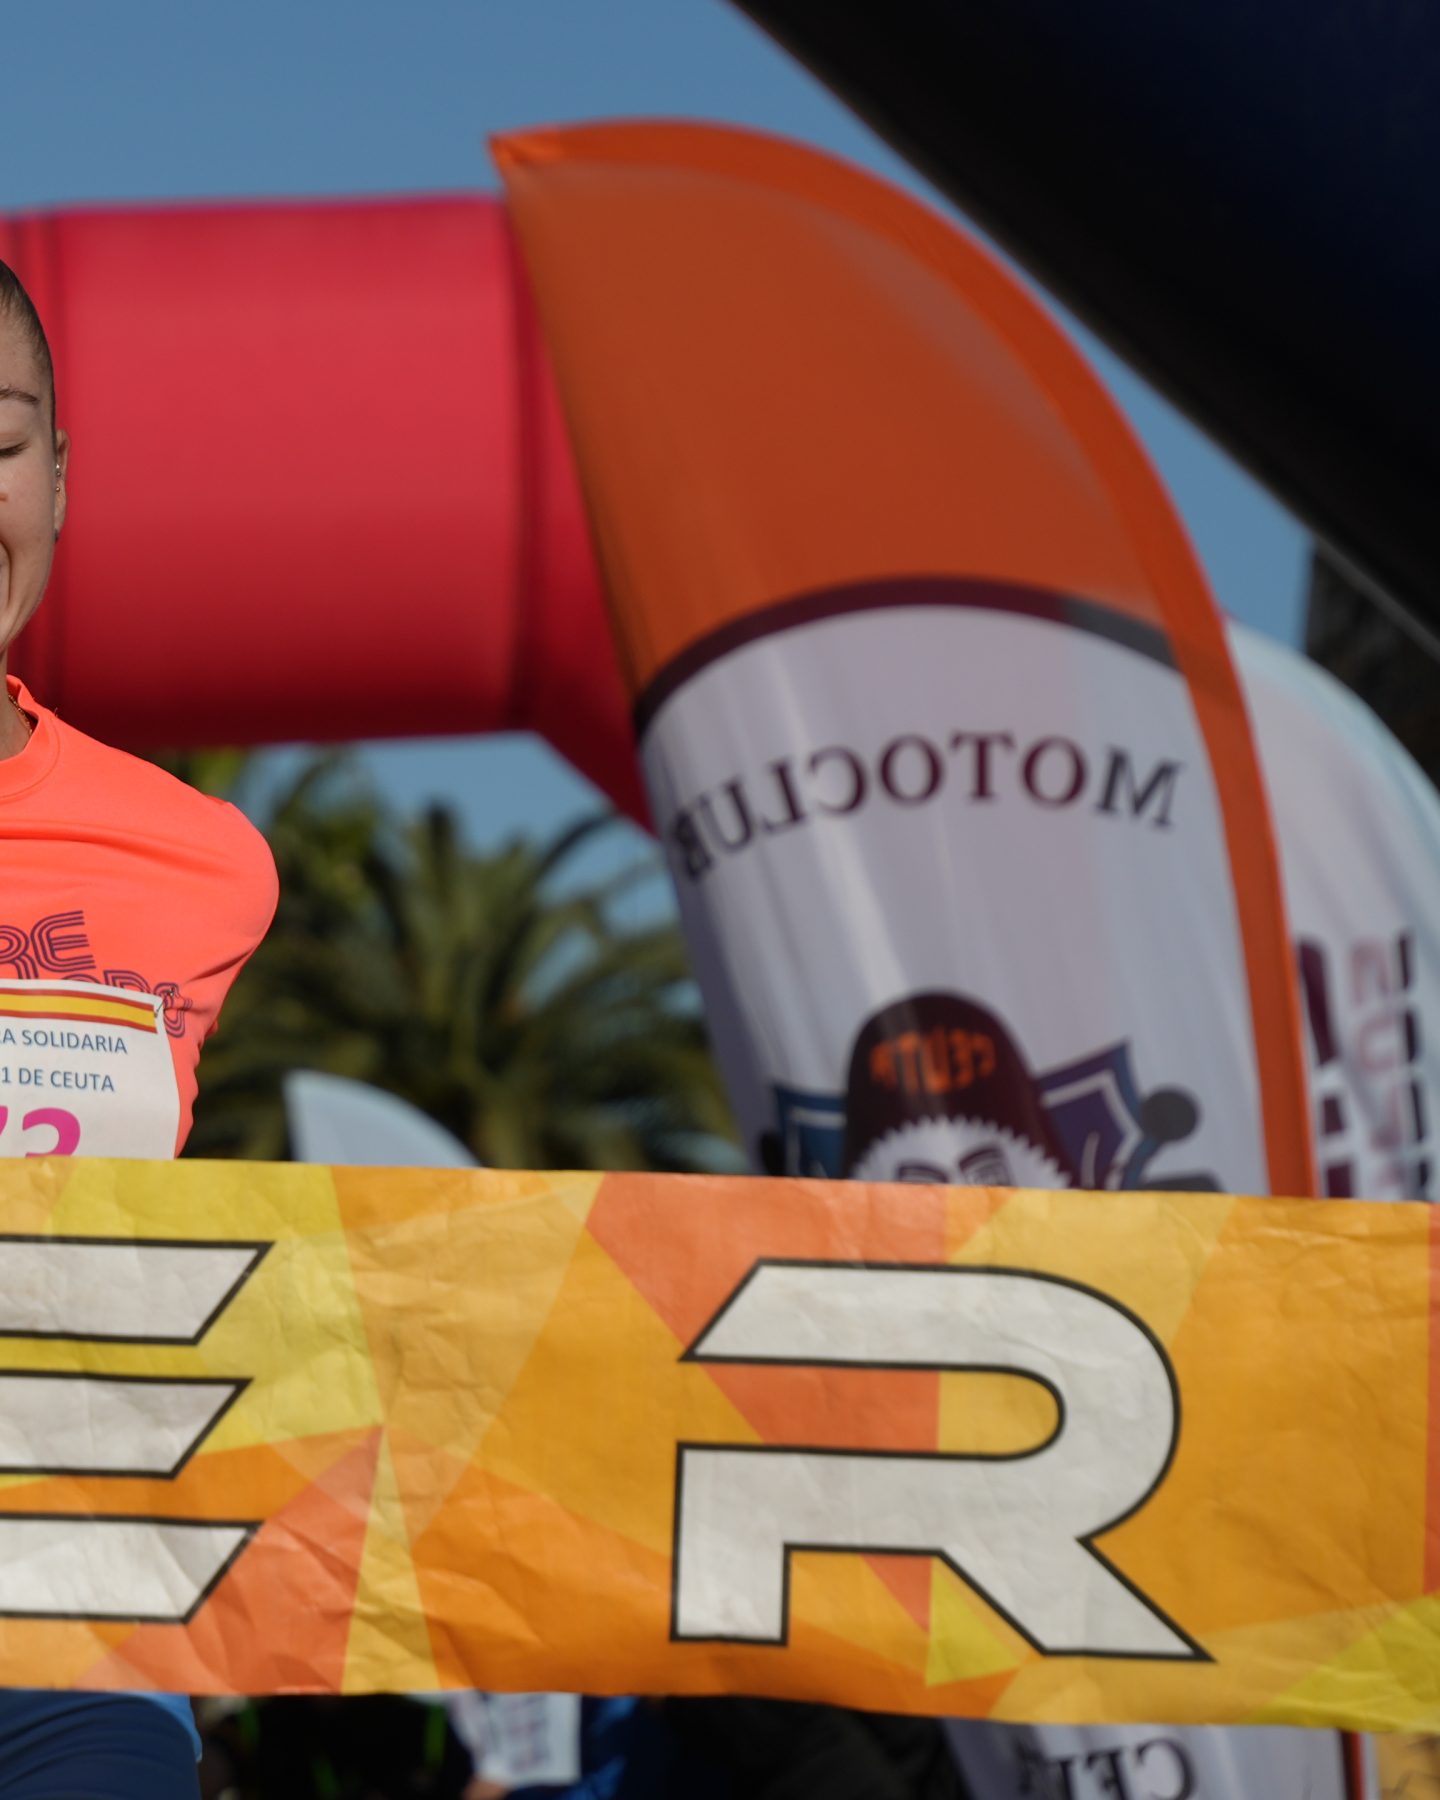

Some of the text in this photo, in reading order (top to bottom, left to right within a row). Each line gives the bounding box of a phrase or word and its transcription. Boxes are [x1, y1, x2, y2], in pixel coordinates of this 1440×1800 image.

[22, 1029, 128, 1055] SOLIDARIA
[18, 1068, 44, 1087] DE
[50, 1070, 116, 1092] CEUTA
